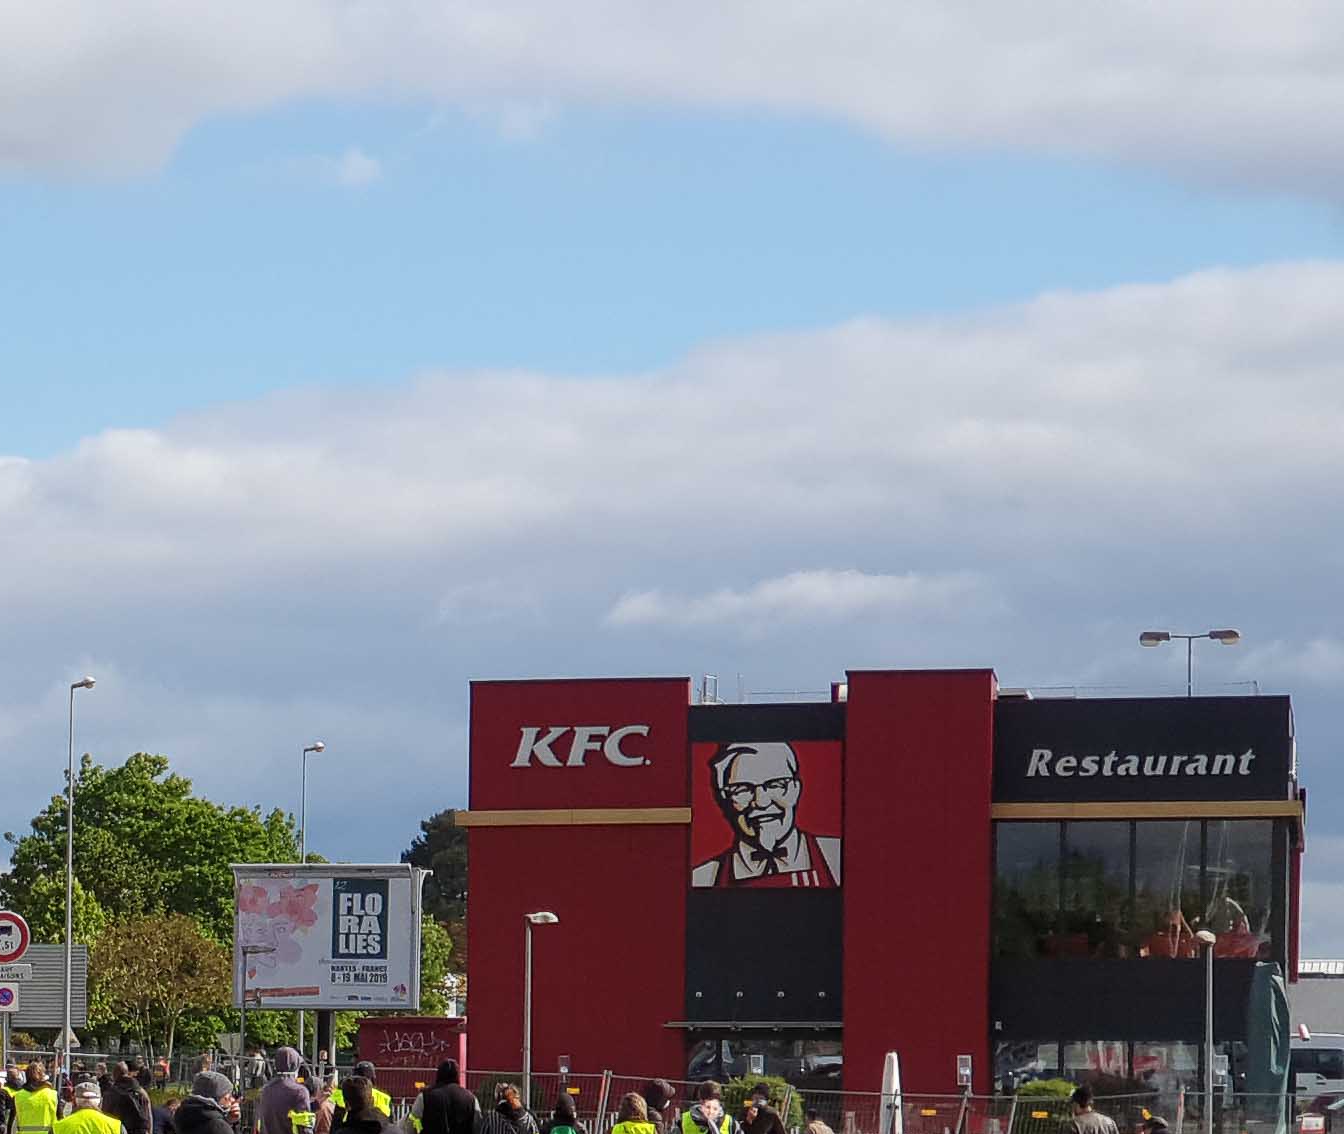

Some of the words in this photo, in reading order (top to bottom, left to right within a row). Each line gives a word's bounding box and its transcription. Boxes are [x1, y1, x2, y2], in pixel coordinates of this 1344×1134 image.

[1026, 748, 1256, 776] Restaurant
[339, 893, 383, 916] FLO
[339, 915, 380, 934] RA
[339, 934, 381, 955] LIES
